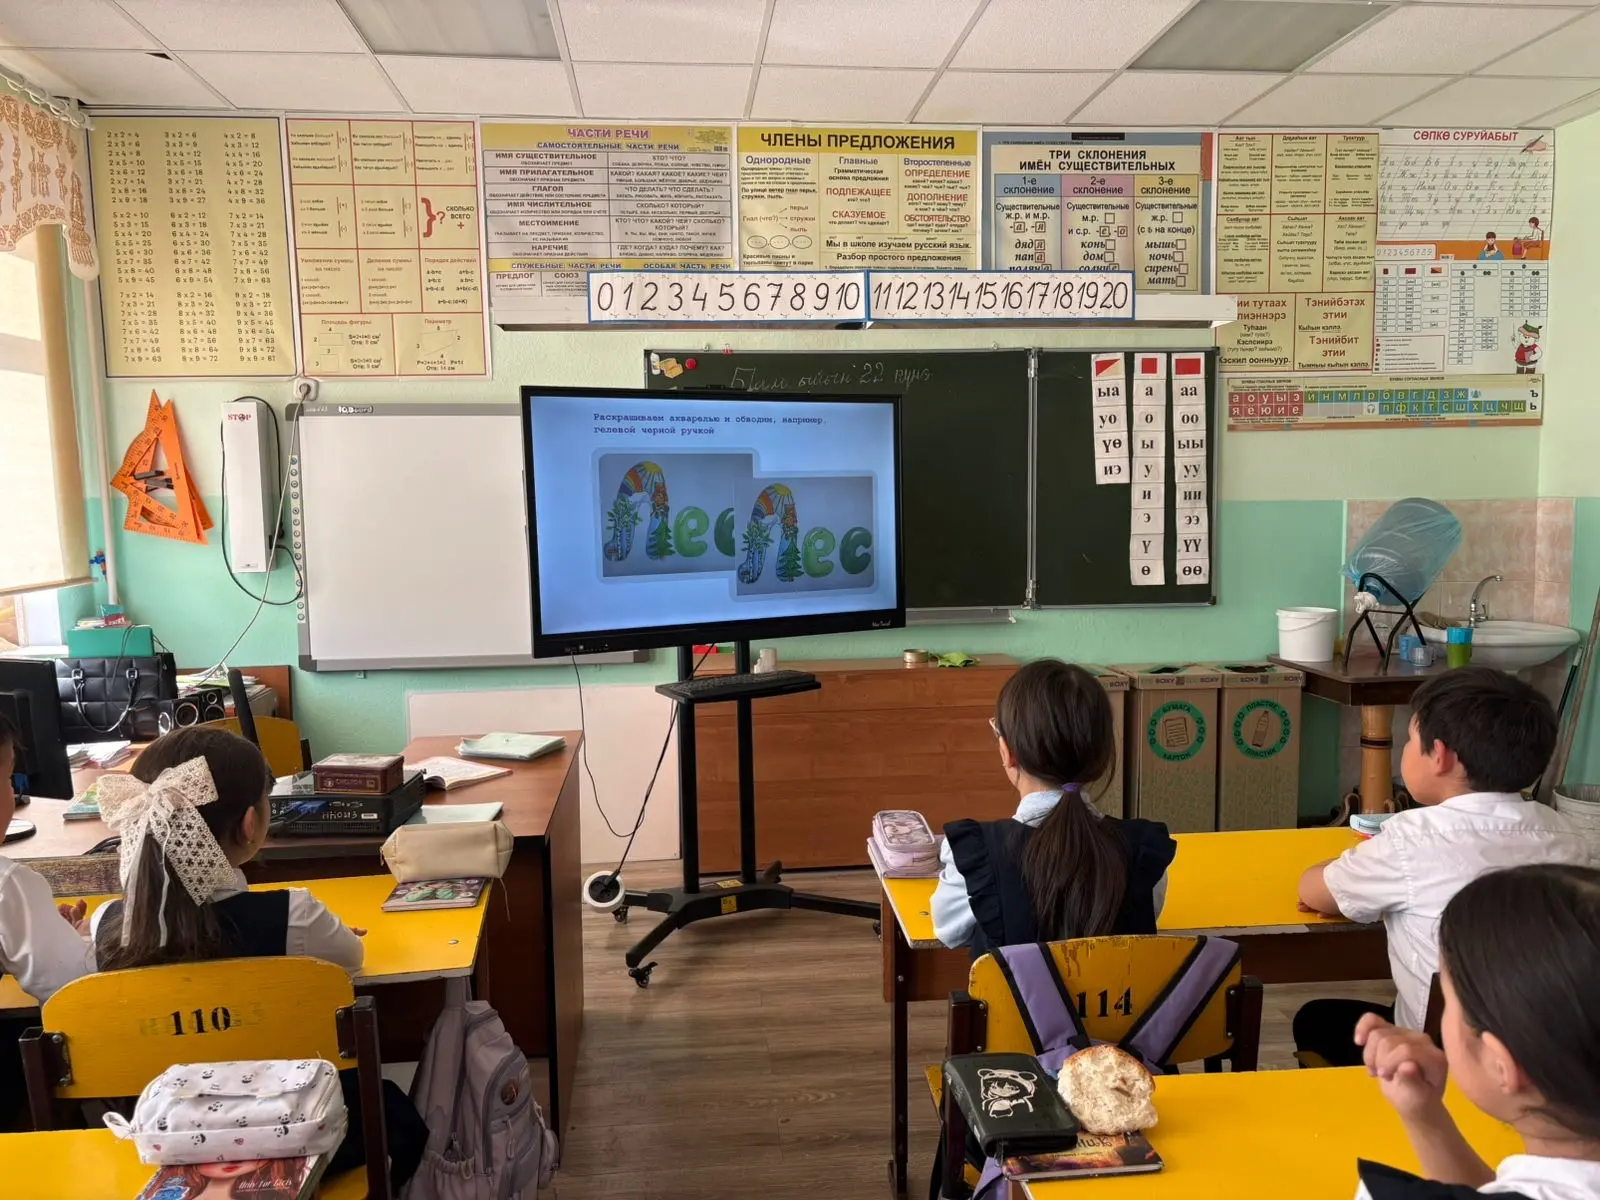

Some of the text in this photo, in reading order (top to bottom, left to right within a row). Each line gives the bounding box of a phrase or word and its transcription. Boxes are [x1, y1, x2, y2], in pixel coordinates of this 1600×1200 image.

[567, 128, 649, 139] ЧАСТИ РЕЧИ
[1414, 129, 1519, 142] СӨПКӨ СУРУЙАБЫТ
[537, 142, 621, 150] САМОСТОЯТЕЛЬНЫЕ
[760, 132, 955, 151] ЧЛЕНЫ ПРЕДЛОЖЕНИЯ
[745, 155, 811, 165] Однородные
[1049, 150, 1146, 160] ТРИ СКЛОНЕНИЯ
[839, 156, 878, 165] Главные
[903, 158, 971, 167] Второстепенные
[1019, 160, 1175, 172] ИМЁН СУЩЕСТВИТЕЛЬНЫХ
[904, 169, 971, 178] ОПРЕДЕЛЕНИЕ
[1023, 176, 1037, 185] 1-е
[1090, 176, 1106, 185] 2-е
[1158, 176, 1174, 185] 3-е
[826, 188, 891, 197] ПОДЛЕЖАЩЕЕ
[1003, 186, 1054, 194] склонение
[1072, 186, 1123, 194] склонение
[1140, 186, 1191, 194] склонение
[907, 193, 968, 202] ДОПОЛНЕНИЕ
[995, 203, 1060, 212] Существительные
[1066, 202, 1130, 211] Существительные
[1135, 202, 1198, 211] Существительные
[832, 210, 886, 219] СКАЗУЕМОЕ
[904, 214, 971, 223] ОБСТОЯТЕЛЬСТВО
[1082, 215, 1099, 223] м.р.
[1151, 215, 1168, 223] ж.р.
[1075, 228, 1091, 236] с.р.
[1167, 225, 1195, 235] конце)
[878, 241, 912, 249] изучаем
[914, 241, 947, 250] русский
[1015, 239, 1044, 249] дядя
[1081, 240, 1106, 249] конь
[1145, 241, 1177, 249] мышь
[837, 253, 867, 262] Разбор
[868, 254, 905, 262] простого
[1015, 253, 1044, 261] папа
[1083, 251, 1104, 260] дом
[1149, 253, 1174, 261] ночь
[1144, 265, 1179, 275] сирень
[496, 272, 535, 280] ПРЕДЛОГ
[597, 282, 861, 311] 0 1 2 3 4 5 6 7 8 9 10
[873, 281, 1128, 310] 11 12 13 14 15 16 17 18 19 20
[1252, 299, 1287, 309] тутаах
[1305, 297, 1366, 307] Тэнийбэтэх
[1322, 311, 1347, 319] этии
[1309, 335, 1359, 345] Тэнийбит
[1322, 349, 1346, 357] этии
[1098, 386, 1120, 397] ыа
[1145, 386, 1153, 397] а
[1180, 386, 1198, 397] аа
[227, 413, 251, 421] STOP
[593, 413, 664, 422] Раскрашиваем
[669, 415, 720, 424] акварелью
[1099, 413, 1117, 428] уо
[1145, 413, 1153, 424] о
[1181, 413, 1199, 424] оо
[681, 426, 714, 436] ручкой
[1141, 439, 1154, 449] ы
[1177, 438, 1204, 449] ыы
[1104, 464, 1121, 475] иэ
[1144, 464, 1153, 478] у
[1183, 463, 1201, 478] уу
[1142, 490, 1151, 500] и
[1183, 489, 1201, 500] ии
[1143, 512, 1151, 523] э
[1184, 515, 1200, 525] ээ
[737, 483, 873, 584] Лес
[1141, 565, 1150, 575] ө
[1182, 565, 1202, 576] өө
[1076, 987, 1133, 1018] 114
[170, 1006, 231, 1036] 110
